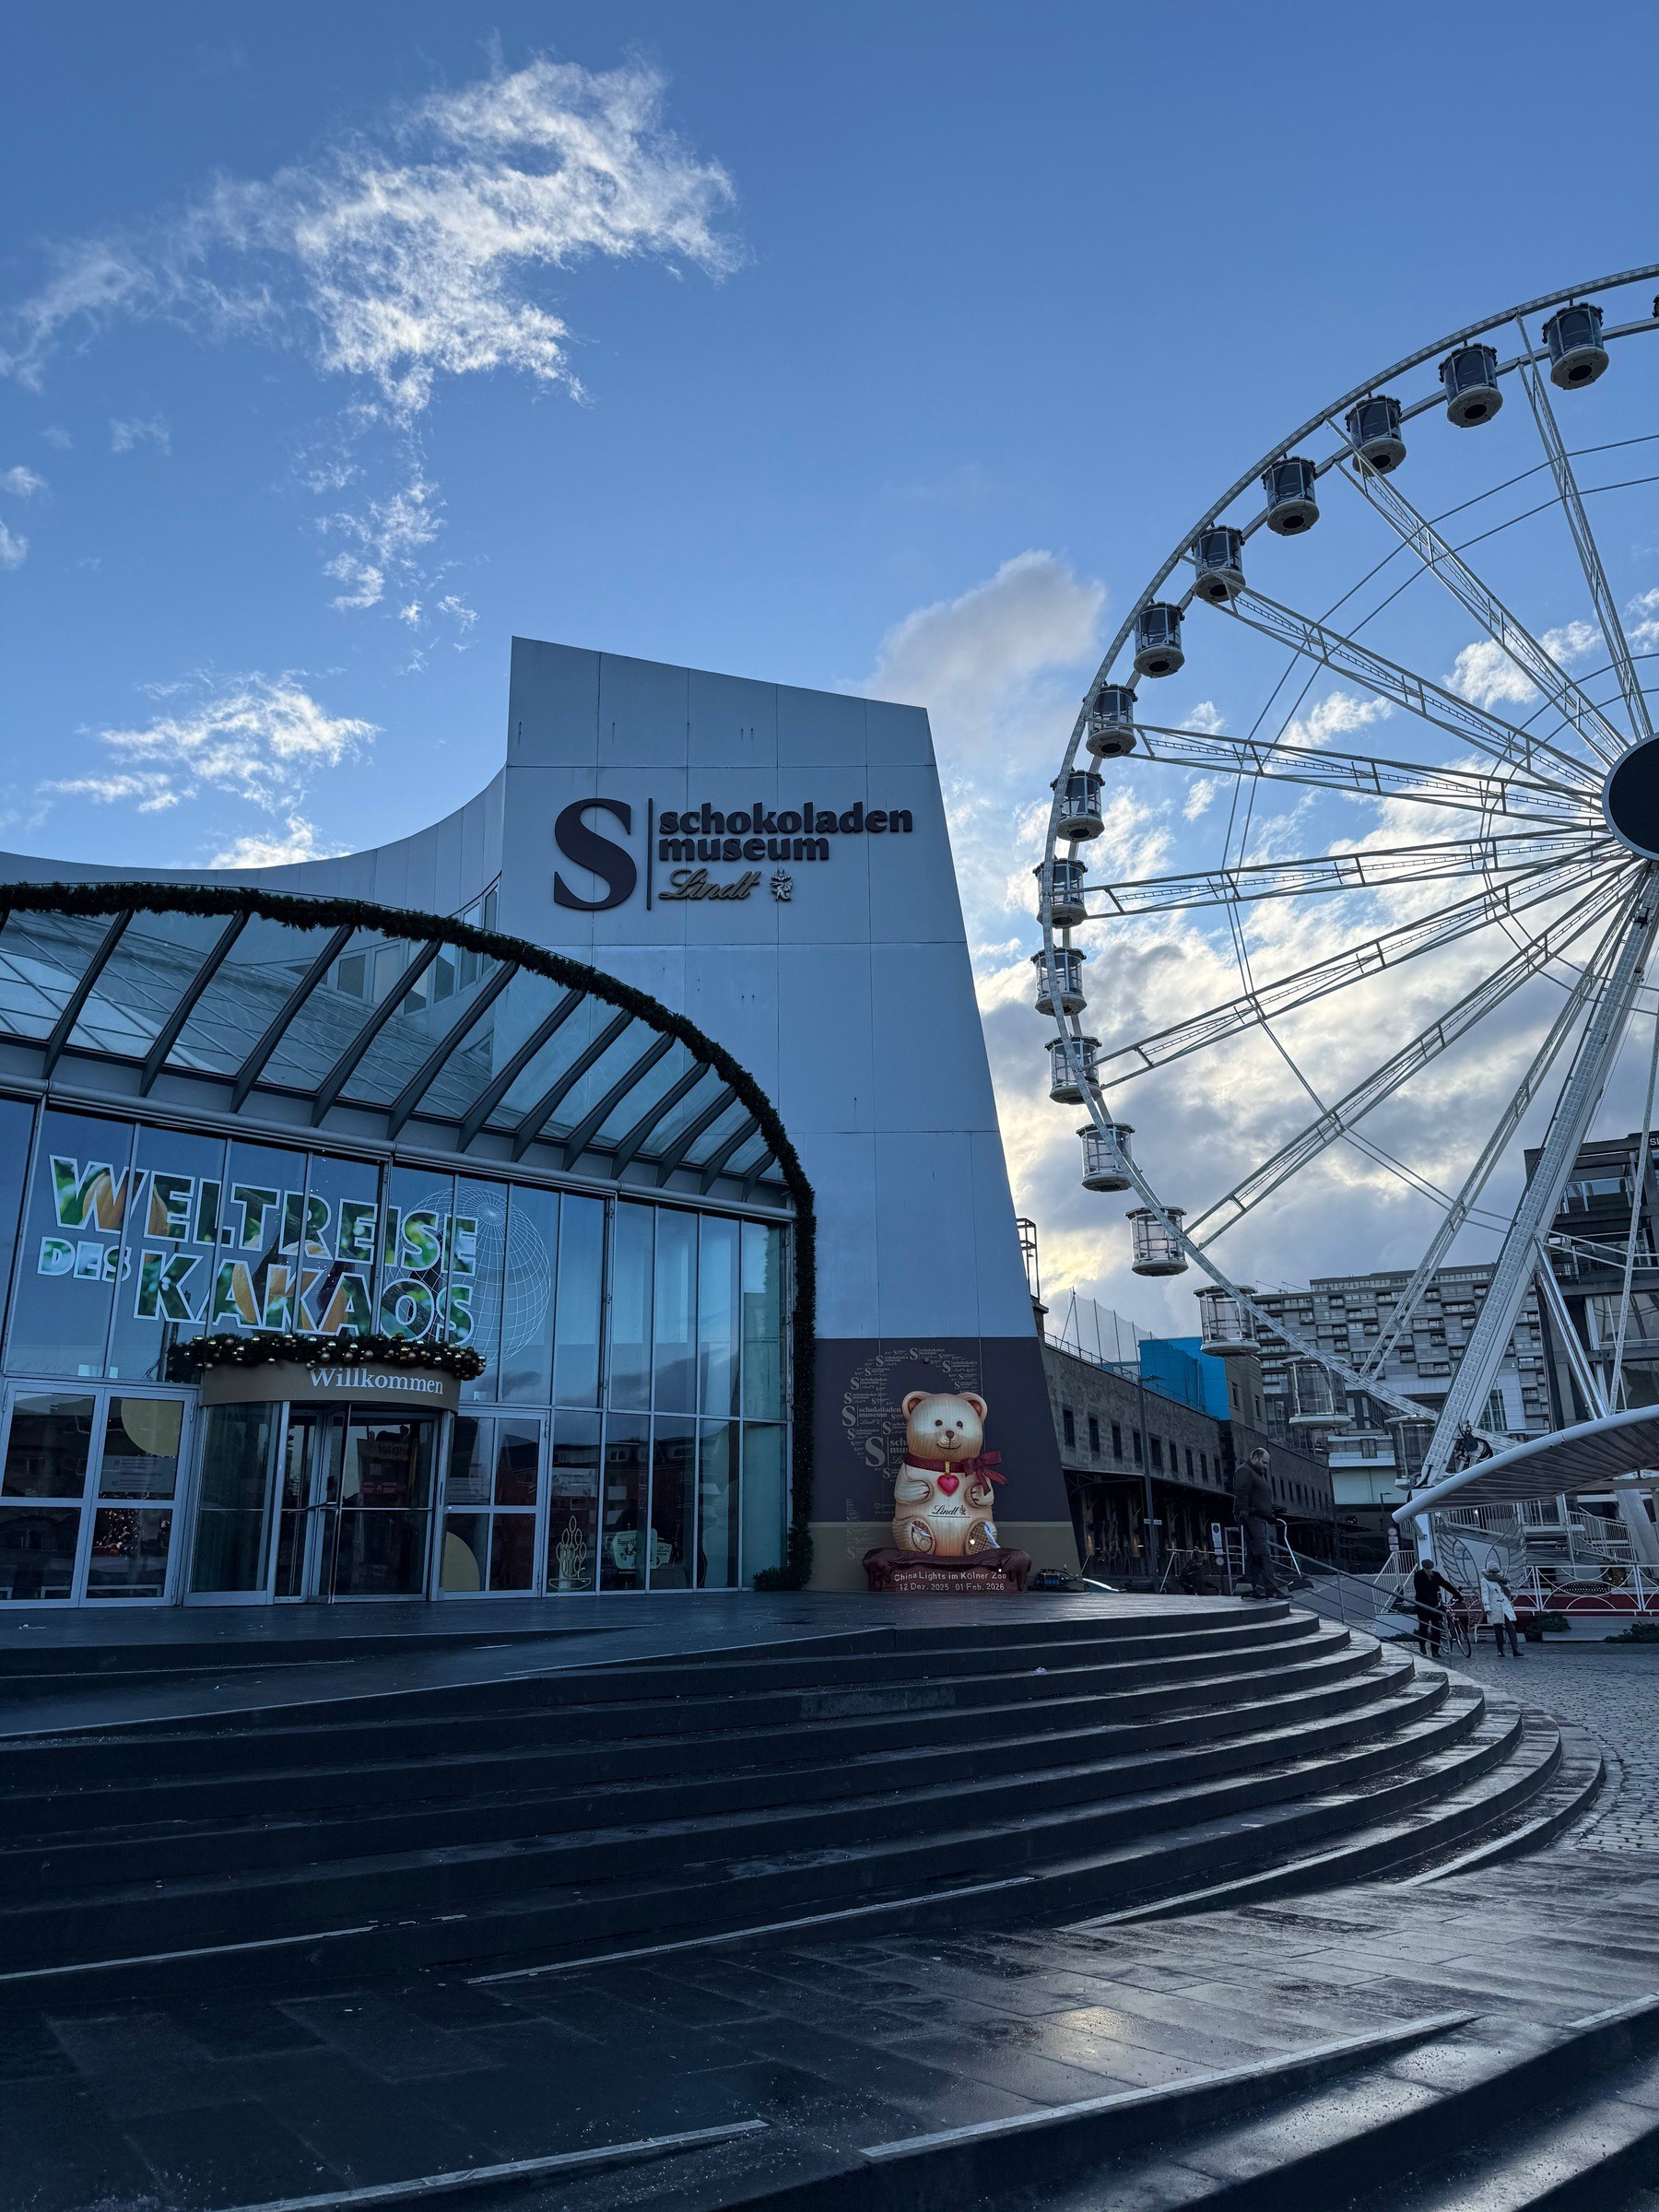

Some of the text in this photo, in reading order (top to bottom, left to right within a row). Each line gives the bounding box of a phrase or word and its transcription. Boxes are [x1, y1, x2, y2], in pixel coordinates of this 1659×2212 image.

[658, 801, 913, 835] schokoladen
[553, 797, 638, 911] S
[658, 836, 830, 861] museum
[658, 868, 762, 900] Lindt
[48, 1154, 478, 1277] WELTREISE
[37, 1237, 134, 1284] DES
[134, 1250, 475, 1347] KAKAOS
[310, 1368, 444, 1395] Willkommen
[865, 1436, 886, 1467] S
[931, 1504, 960, 1516] Lindt
[894, 1572, 917, 1582] China
[919, 1571, 946, 1581] Lights
[991, 1571, 1006, 1580] Zoo
[911, 1583, 929, 1591] Dez.
[986, 1583, 1005, 1591] 2026
